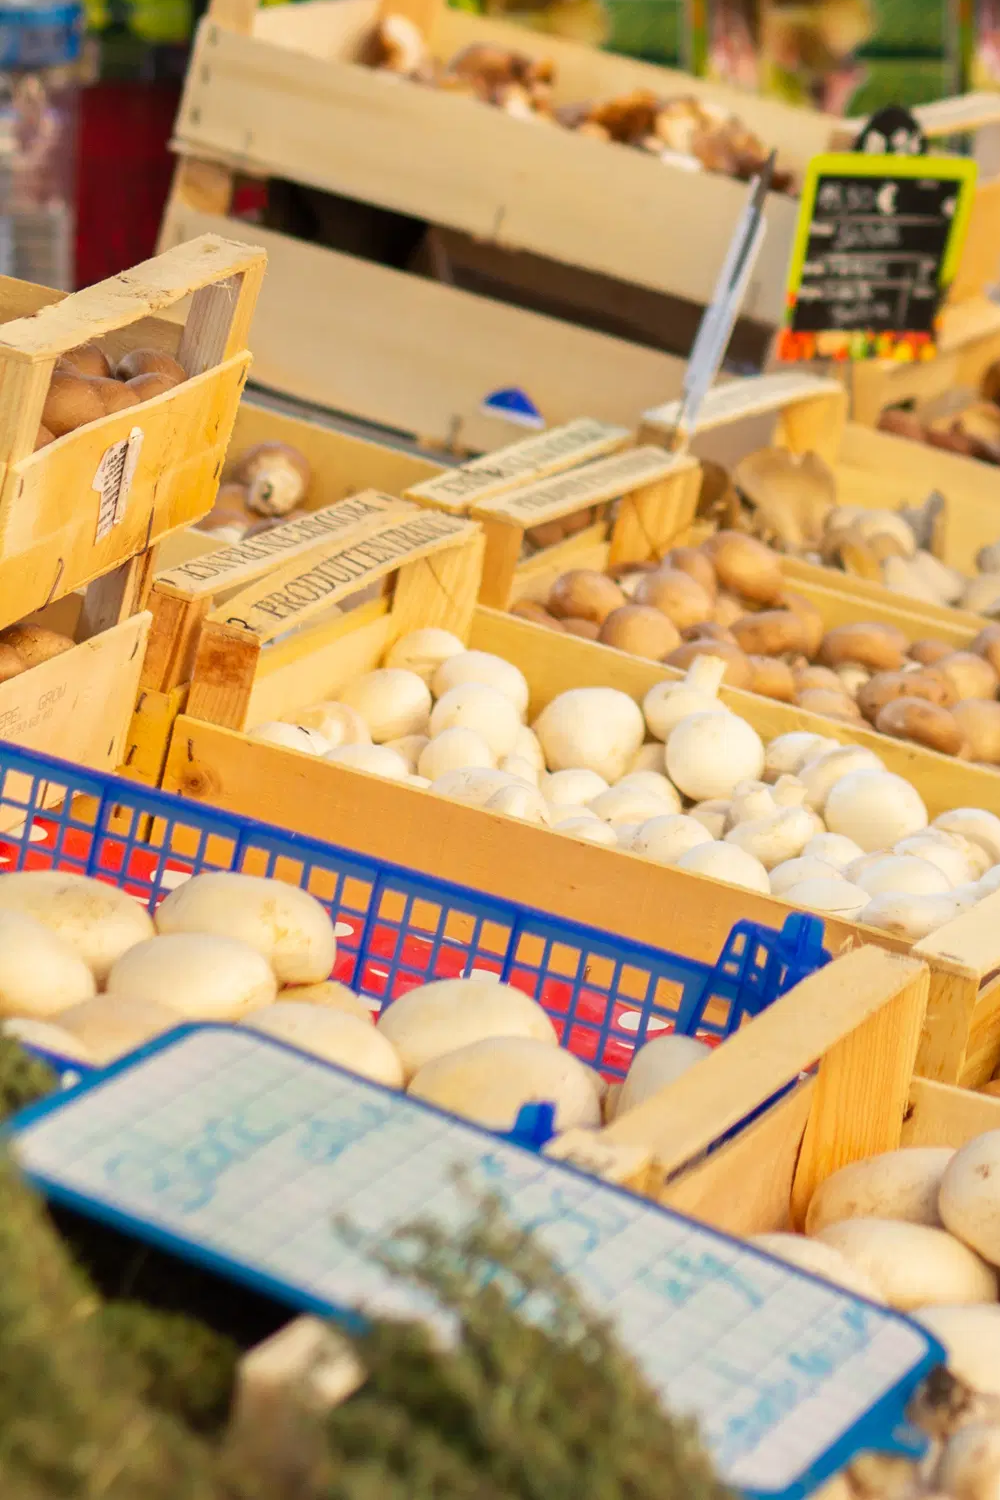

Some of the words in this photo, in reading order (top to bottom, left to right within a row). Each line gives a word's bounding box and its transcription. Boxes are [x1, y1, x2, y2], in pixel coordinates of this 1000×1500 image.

[171, 541, 265, 583] FRANCE
[251, 546, 370, 619] PRODUIT
[349, 537, 402, 566] EN
